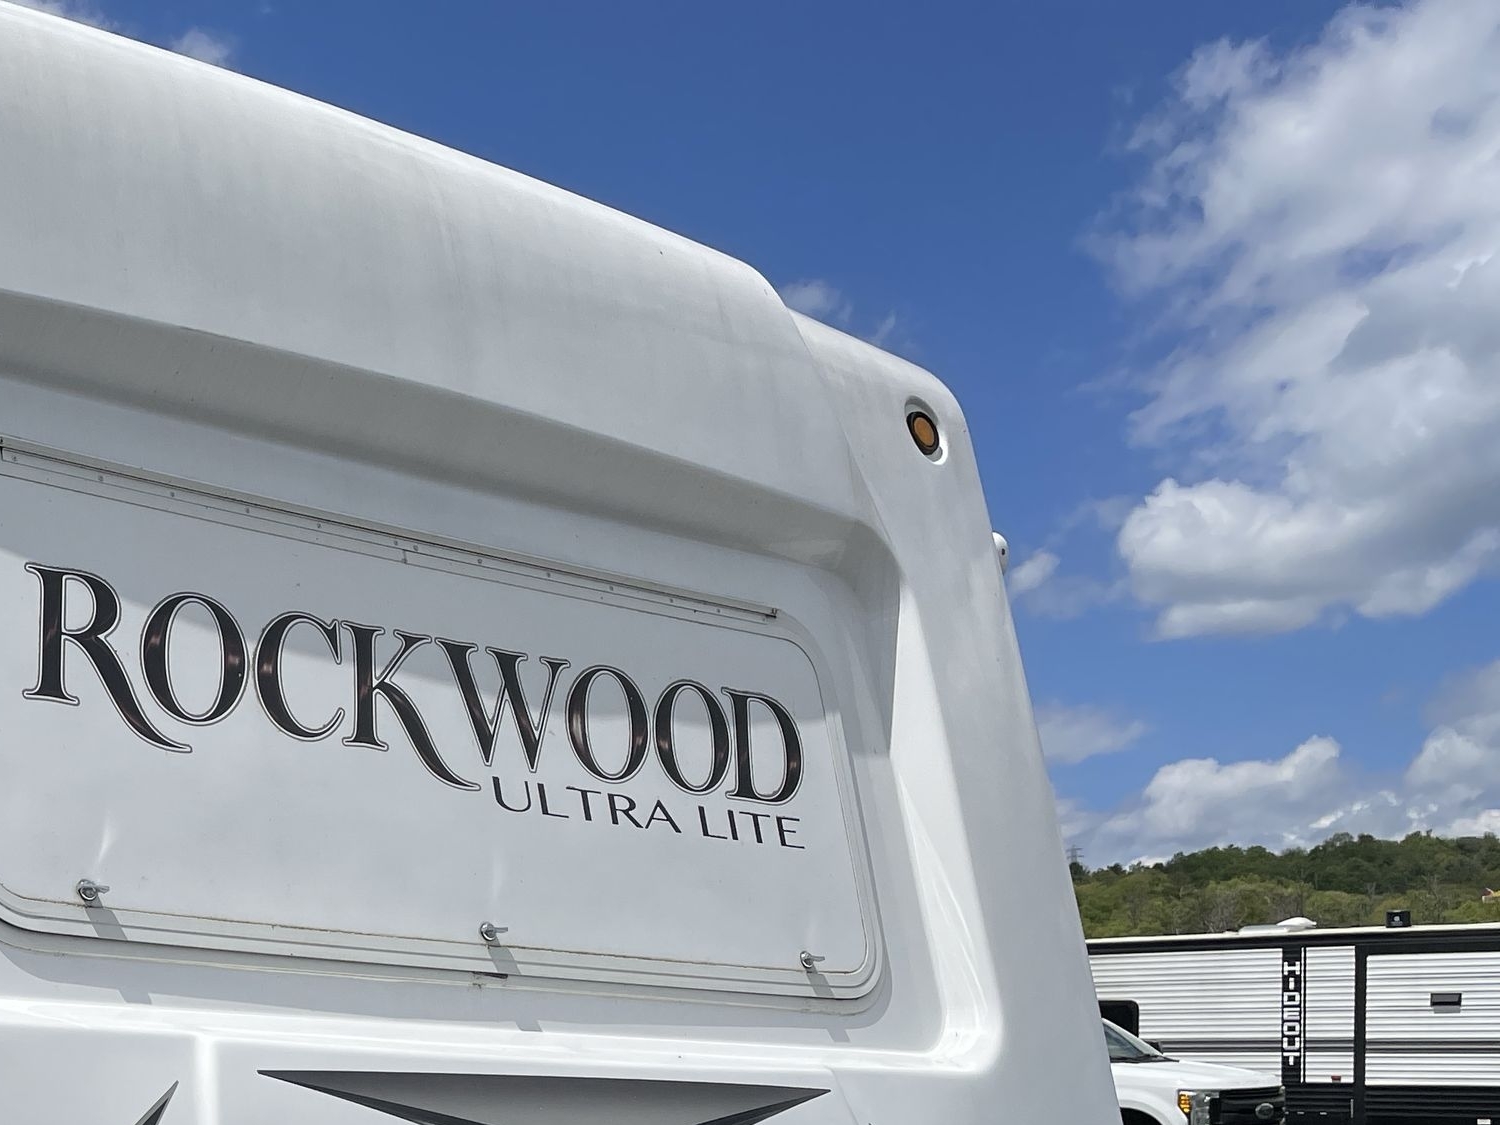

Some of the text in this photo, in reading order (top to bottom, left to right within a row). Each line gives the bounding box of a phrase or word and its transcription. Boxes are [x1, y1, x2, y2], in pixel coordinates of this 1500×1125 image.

[23, 562, 805, 806] ROCKWOOD
[492, 775, 806, 849] ULTRA LITE
[1282, 961, 1300, 1066] HIDEOUT
